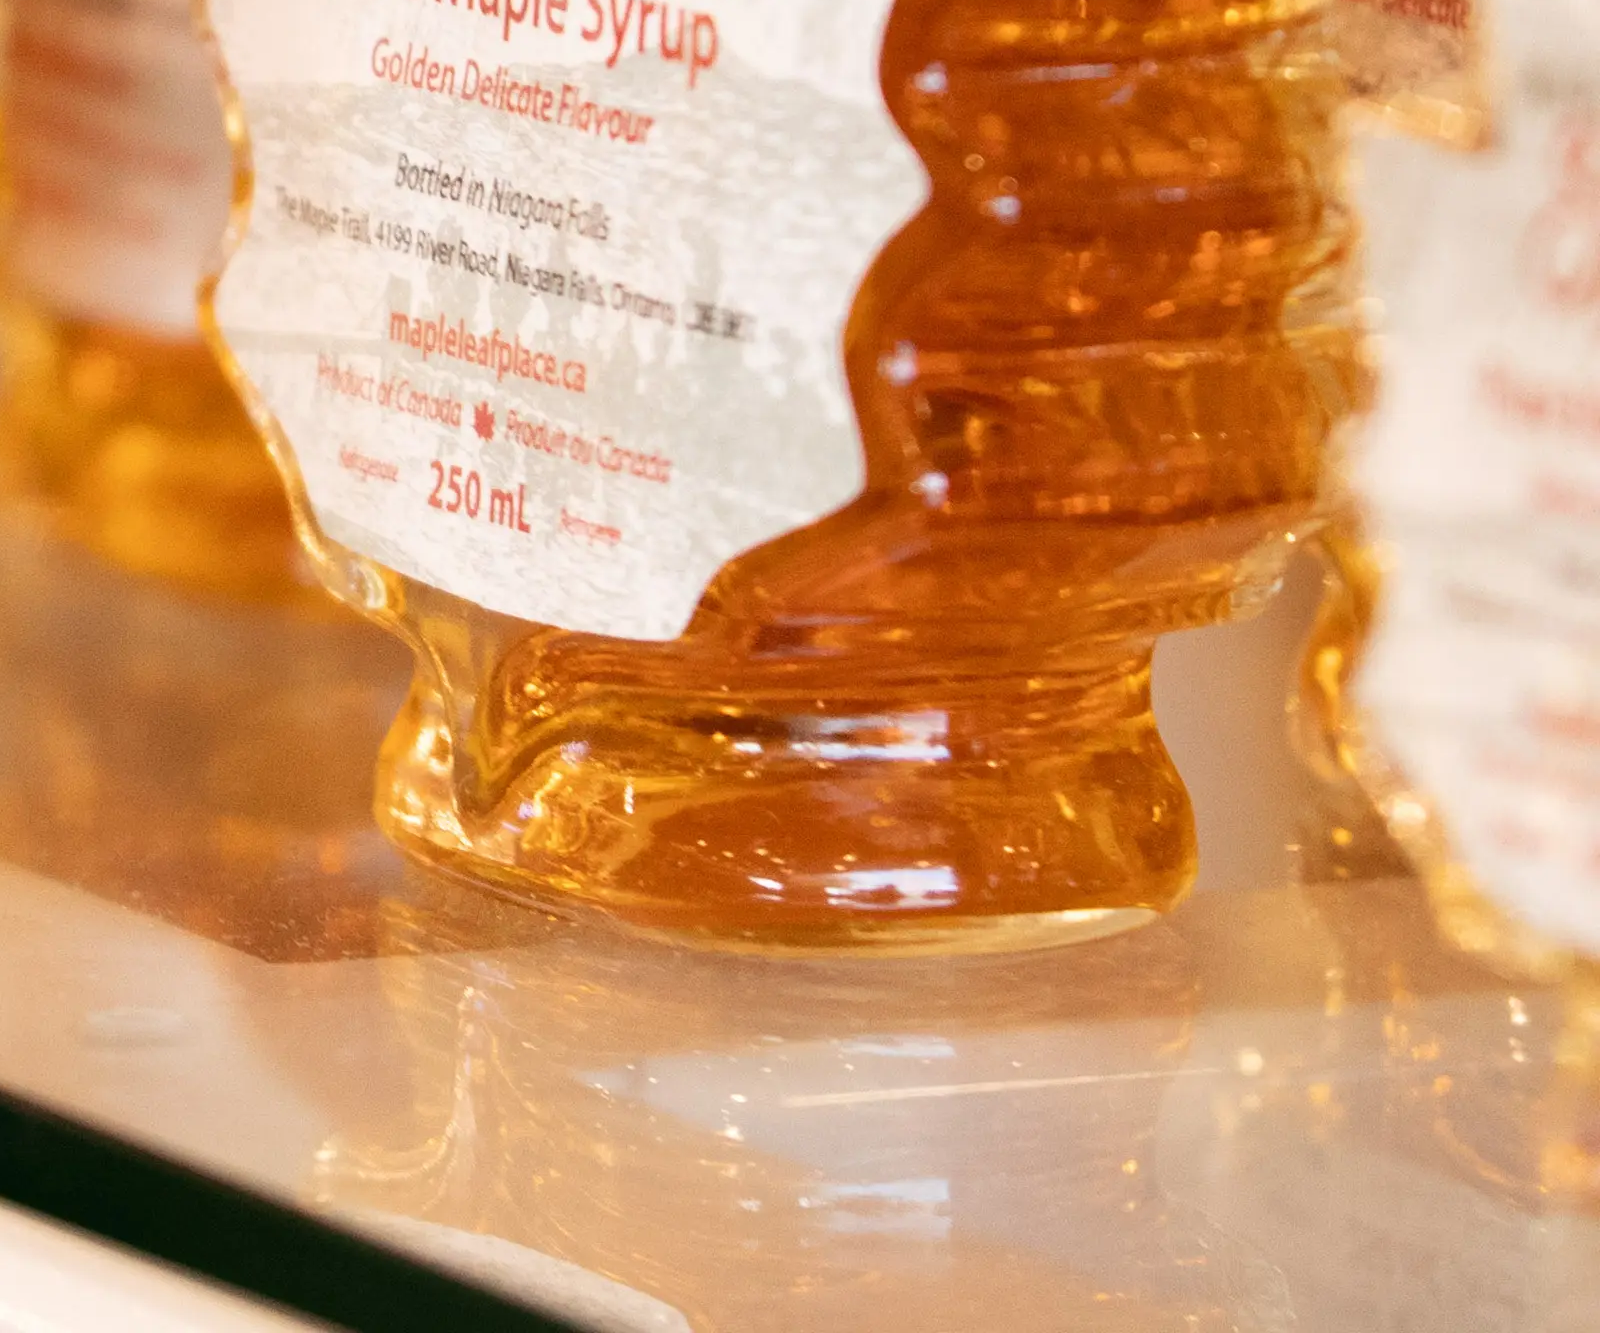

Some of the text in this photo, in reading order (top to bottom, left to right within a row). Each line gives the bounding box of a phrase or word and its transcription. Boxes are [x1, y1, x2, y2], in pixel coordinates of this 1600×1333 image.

[371, 36, 655, 145] Golden Delicate Flavour
[394, 151, 611, 241] Bottled in Niagara Falls
[374, 220, 412, 254] 4199
[415, 229, 456, 265] River
[504, 252, 566, 297] Niagara
[389, 310, 587, 394] mapleleafplace.ca
[376, 373, 398, 408] of
[397, 379, 463, 428] Canada
[427, 459, 482, 519] 250
[488, 483, 532, 534] mL
